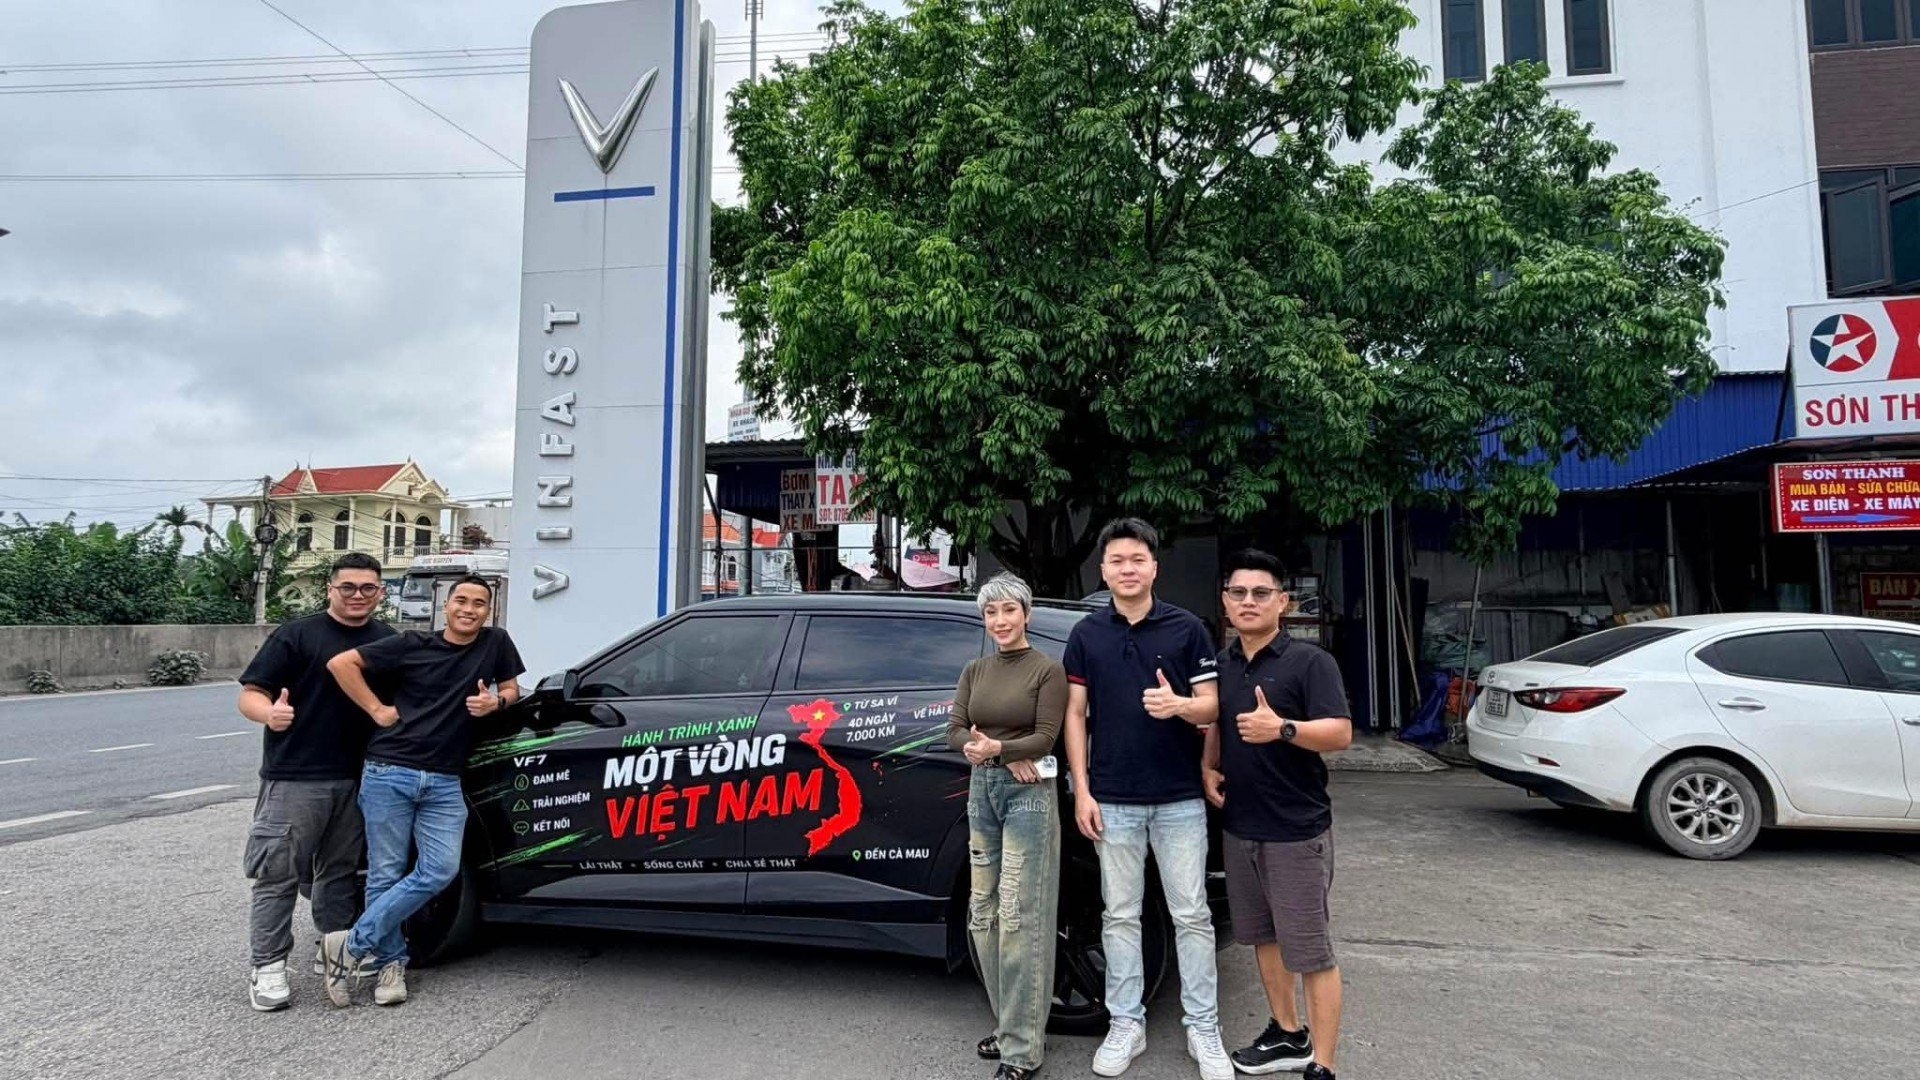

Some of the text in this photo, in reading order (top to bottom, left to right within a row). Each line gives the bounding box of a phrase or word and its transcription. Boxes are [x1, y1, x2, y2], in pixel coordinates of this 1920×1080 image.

[1805, 394, 1869, 427] SƠN
[533, 301, 580, 601] VINFAST
[783, 472, 809, 490] BƠM
[1803, 467, 1837, 480] SƠN
[1790, 484, 1817, 495] MUA
[1820, 481, 1846, 495] BÁN
[781, 493, 805, 510] THAY
[1791, 499, 1810, 511] XE
[1864, 498, 1884, 510] XE
[784, 514, 797, 531] XE
[855, 699, 869, 710] TỪ
[870, 699, 884, 708] SA
[928, 705, 945, 717] HẢI
[848, 712, 896, 729] 40 NGÀY
[621, 715, 758, 748] HÀNH TRÌNH XANH
[846, 725, 896, 743] 7.000 KM
[513, 754, 548, 767] VF7
[603, 733, 787, 791] MỘT VÒNG
[533, 768, 570, 785] ĐAM MÊ
[533, 791, 590, 808] TRẢI NGHIỆM
[606, 768, 824, 840] VIỆT NAM
[533, 817, 570, 832] KẾT NỐI
[865, 847, 930, 860] ĐẾN CÀ MAU
[644, 858, 704, 870] SỐNG CHẤT
